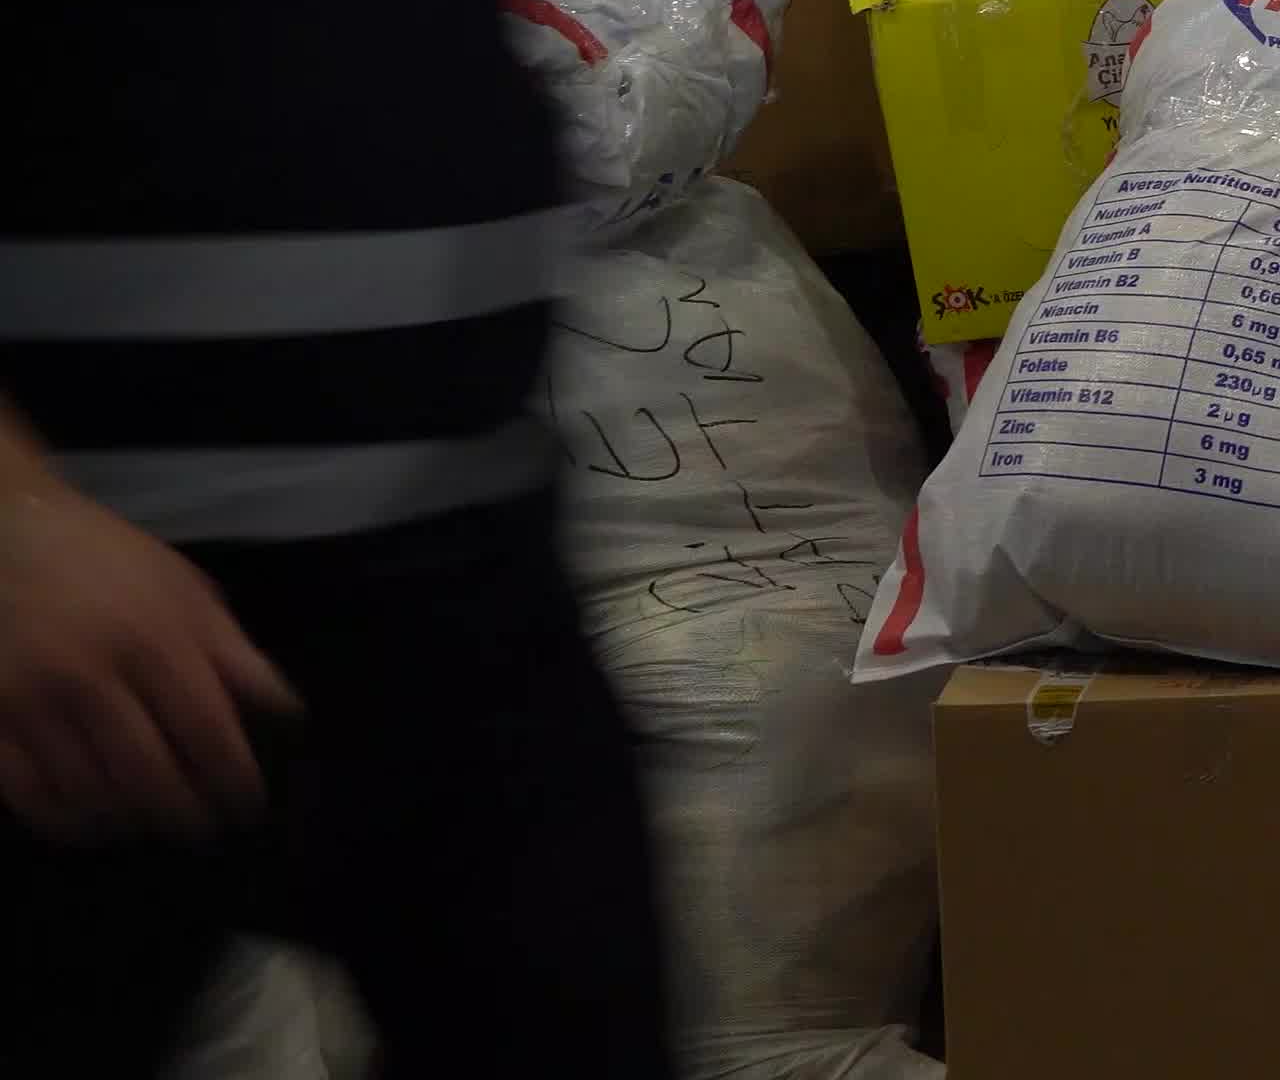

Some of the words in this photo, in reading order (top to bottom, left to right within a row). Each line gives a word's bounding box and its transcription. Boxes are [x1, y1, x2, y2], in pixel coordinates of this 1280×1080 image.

[1095, 199, 1165, 222] Nutritient
[1082, 226, 1137, 247] Vitamin
[1067, 251, 1122, 271] Vitamin
[1055, 277, 1111, 295] Vitamin
[1040, 301, 1099, 320] Niancin
[1231, 312, 1244, 328] 6
[1248, 322, 1280, 340] mg
[1029, 329, 1090, 346] Vitamin
[1094, 329, 1120, 345] B6
[1222, 343, 1266, 367] 0,65
[1018, 358, 1069, 375] Folate
[1009, 388, 1073, 406] Vitamin
[1077, 389, 1114, 406] B12
[998, 419, 1036, 436] Zinc
[1200, 434, 1214, 451] 6
[1218, 441, 1250, 462] mg
[991, 451, 1024, 469] Iron
[1193, 467, 1208, 485] 3
[1212, 474, 1244, 496] mg
